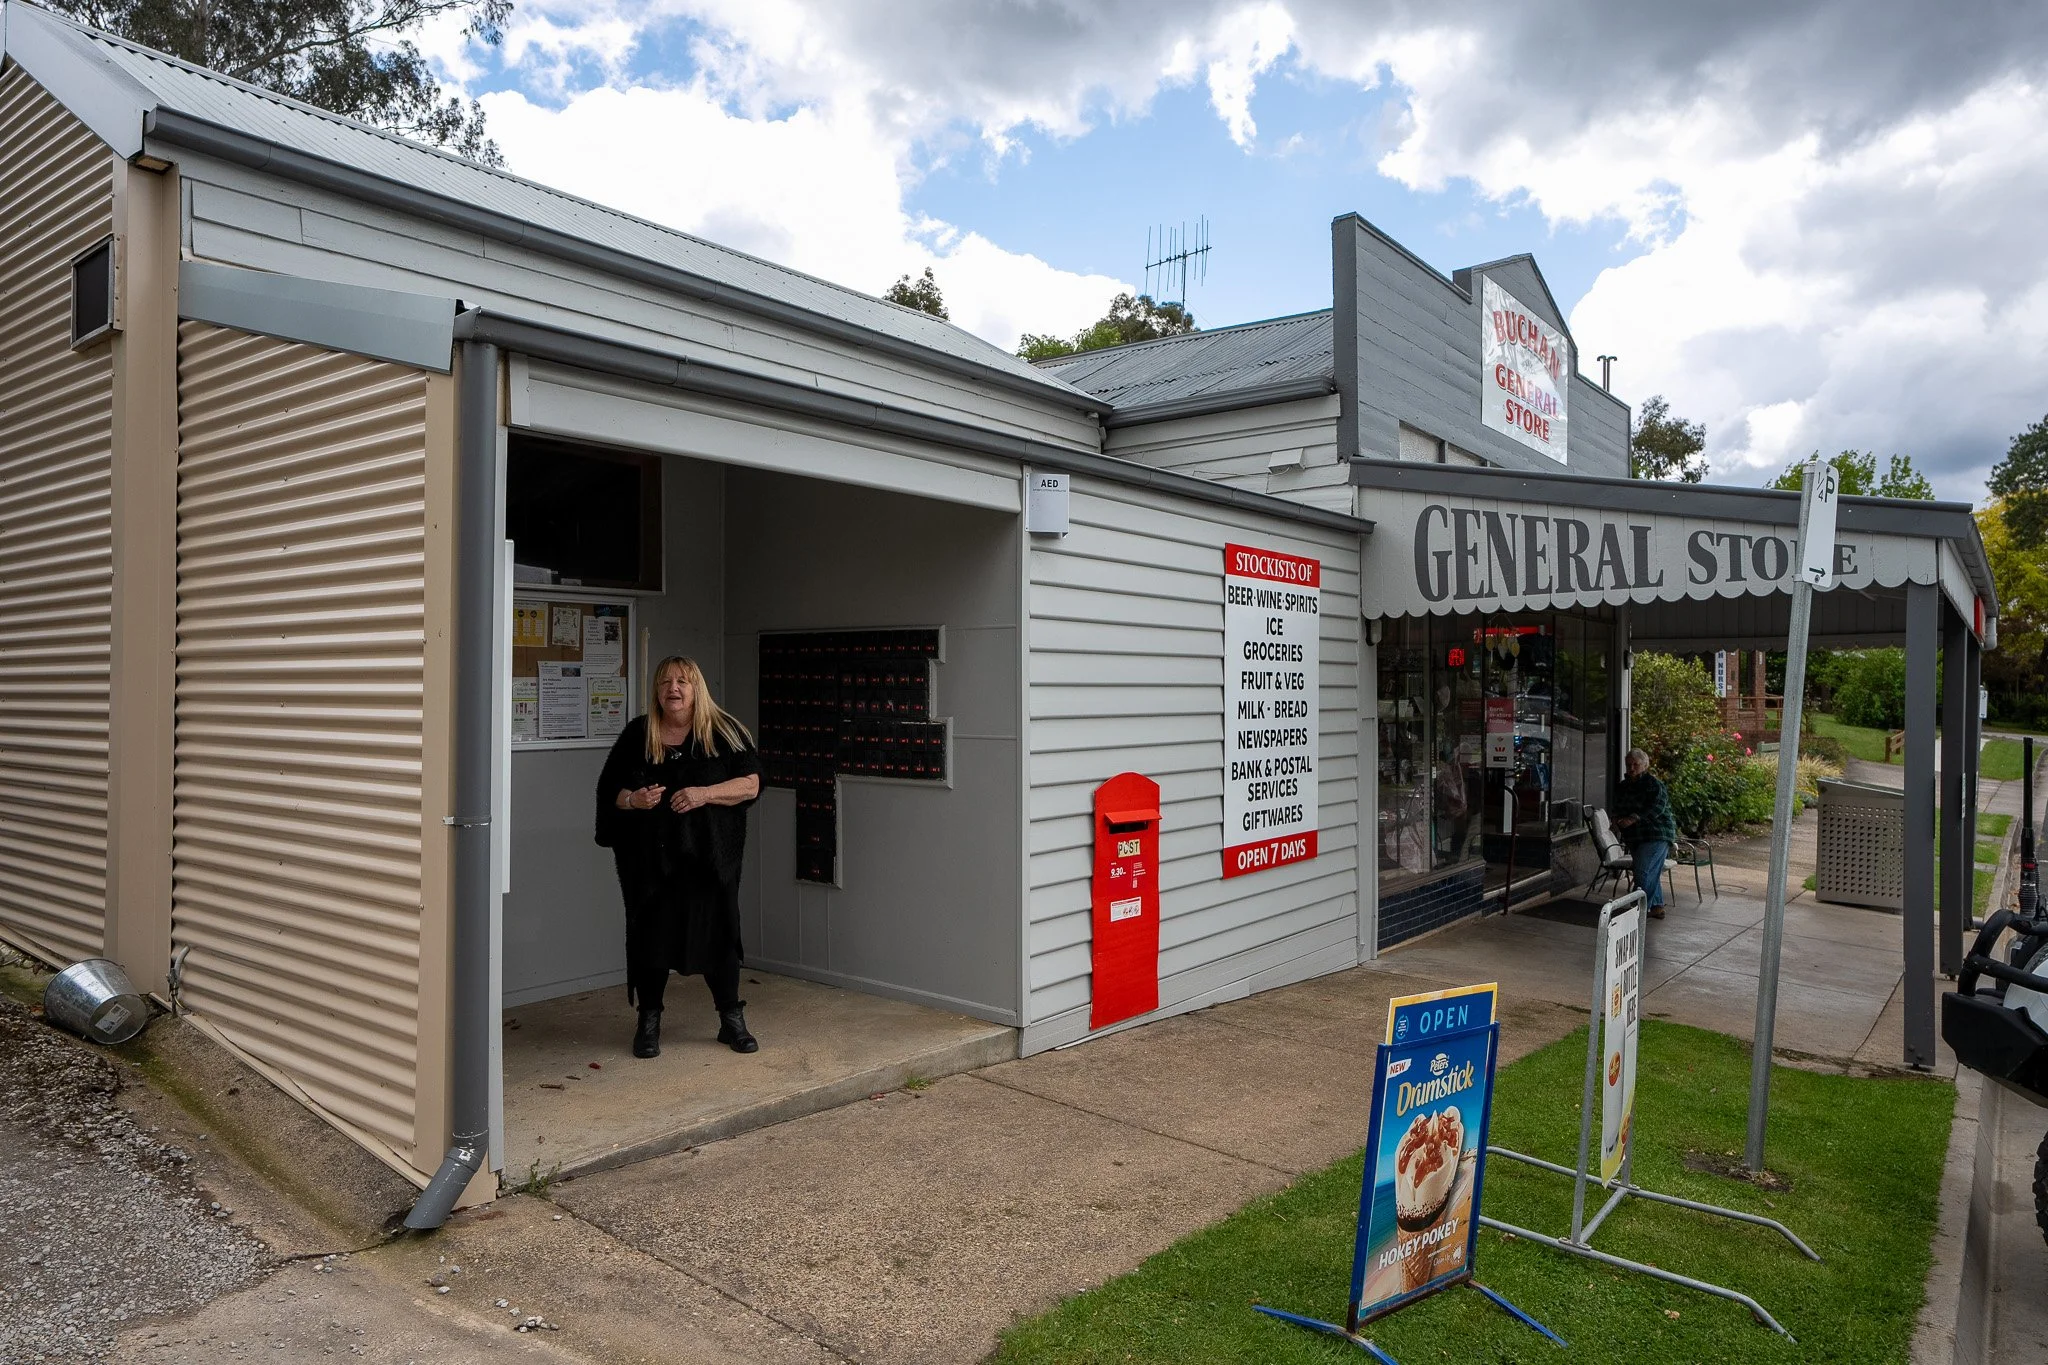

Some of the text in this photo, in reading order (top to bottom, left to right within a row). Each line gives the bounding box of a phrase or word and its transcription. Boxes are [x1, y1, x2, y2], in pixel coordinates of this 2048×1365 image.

[1492, 310, 1560, 384] BUCHAN
[1495, 363, 1559, 420] GENERAL
[1505, 399, 1550, 442] STORE
[1235, 551, 1313, 582] STOCKISTS OF
[1413, 503, 1860, 603] GENERAL STOE
[1266, 617, 1284, 636] ICE
[1243, 641, 1303, 662] GROCERIES
[1241, 671, 1305, 691] FRUIT & VEG
[1238, 700, 1308, 720] MILK BREAD
[1238, 726, 1308, 750] NEWSPAPERS
[1232, 755, 1312, 782] BANK & POSTAL
[1247, 778, 1298, 803] SERVICES
[1242, 806, 1303, 832] GIFTWARES
[1118, 840, 1140, 855] POST
[1238, 838, 1306, 870] OPEN 7 DAYS
[1615, 928, 1638, 969] SWAP ANY
[1623, 962, 1638, 998] BOTTLE
[1419, 1004, 1468, 1034] OPEN
[1626, 994, 1637, 1028] HERE
[1390, 1062, 1406, 1074] NEW
[1396, 1060, 1474, 1117] Drumstick
[1378, 1235, 1421, 1270] HOKEY
[1422, 1218, 1460, 1250] POKEY
